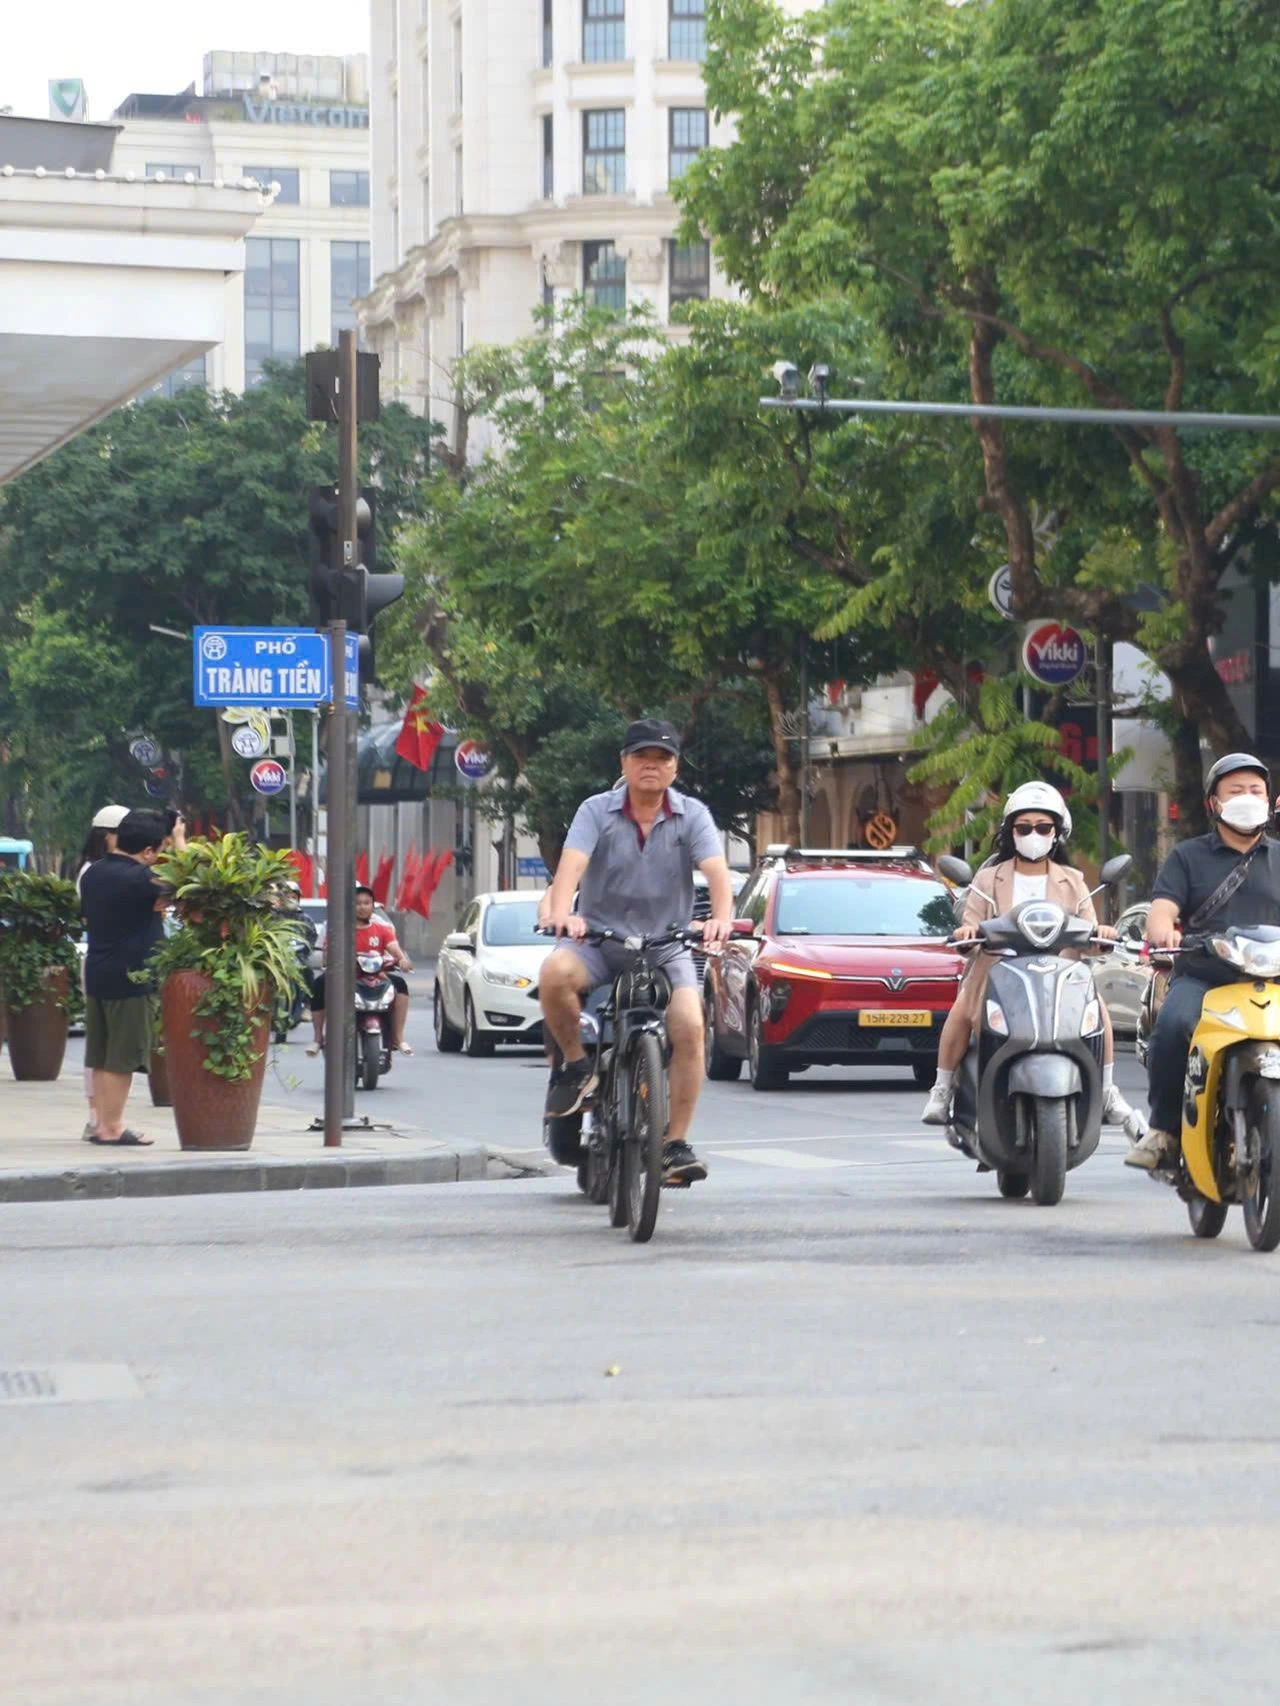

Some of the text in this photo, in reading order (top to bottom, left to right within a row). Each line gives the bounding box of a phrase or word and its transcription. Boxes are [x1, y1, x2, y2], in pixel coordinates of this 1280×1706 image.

[255, 636, 297, 655] PHỐ
[1030, 632, 1078, 661] Vikki
[206, 661, 273, 694] TRÀNG
[278, 659, 321, 694] TIỀN
[460, 748, 490, 764] Vikk
